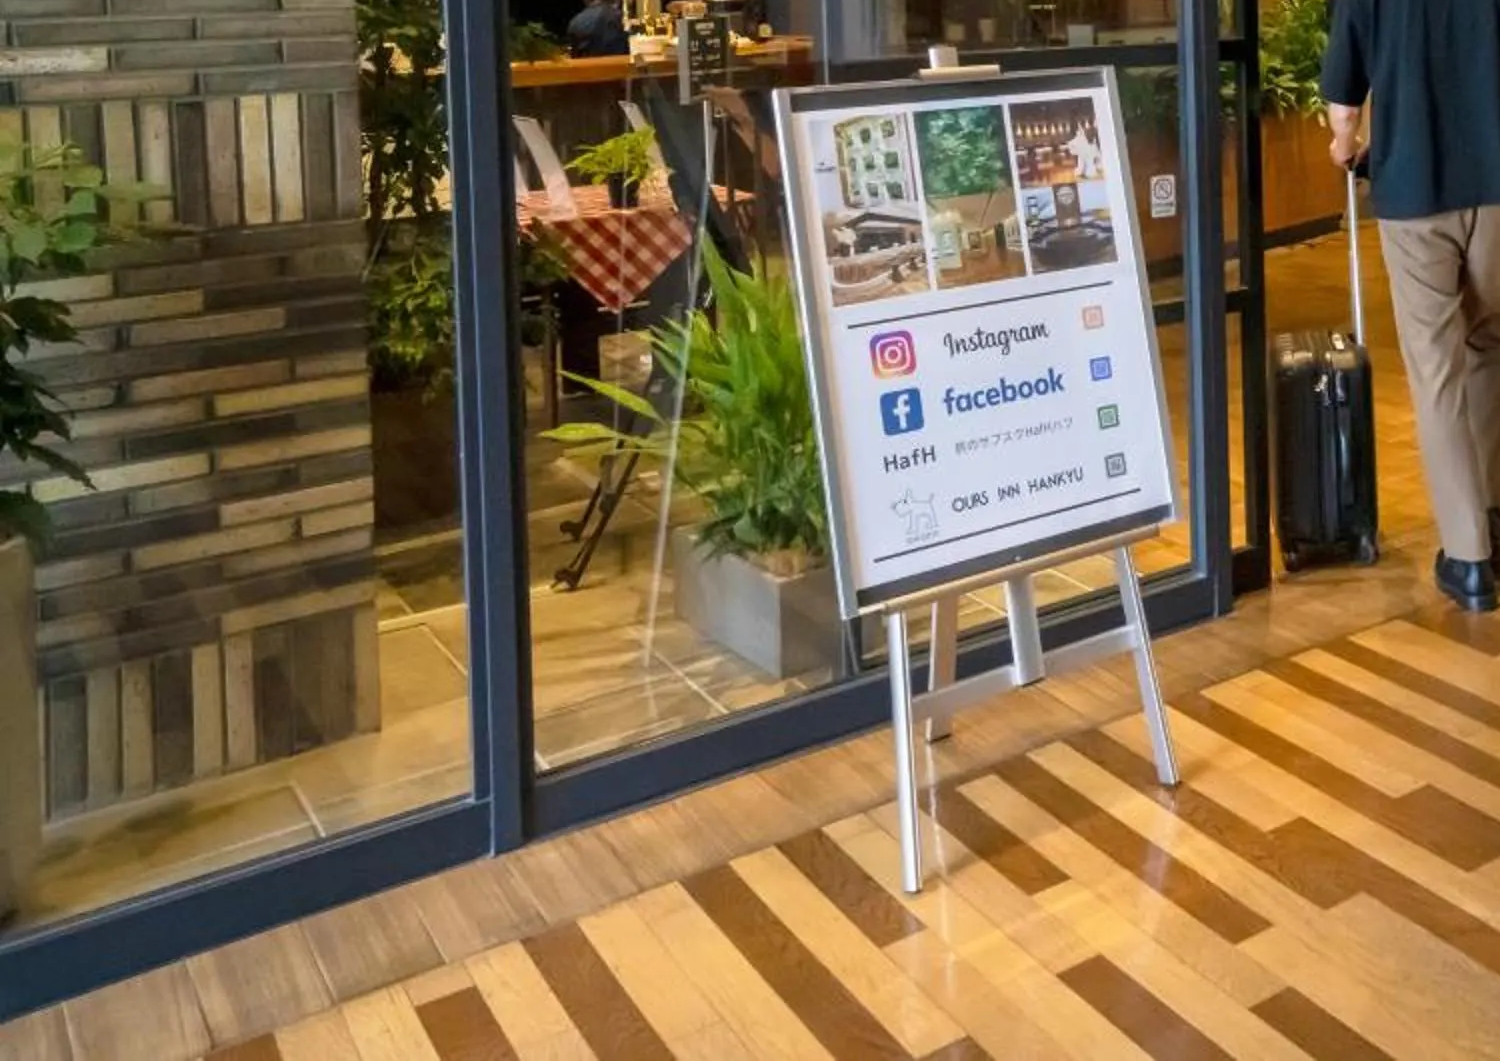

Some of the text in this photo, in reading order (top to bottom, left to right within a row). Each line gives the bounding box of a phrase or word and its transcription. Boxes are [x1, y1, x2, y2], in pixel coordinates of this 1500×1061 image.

[943, 322, 1049, 358] Instagram
[942, 367, 1065, 416] facebook
[883, 445, 936, 474] HafH
[951, 467, 1083, 513] OURS INN HANKYU
